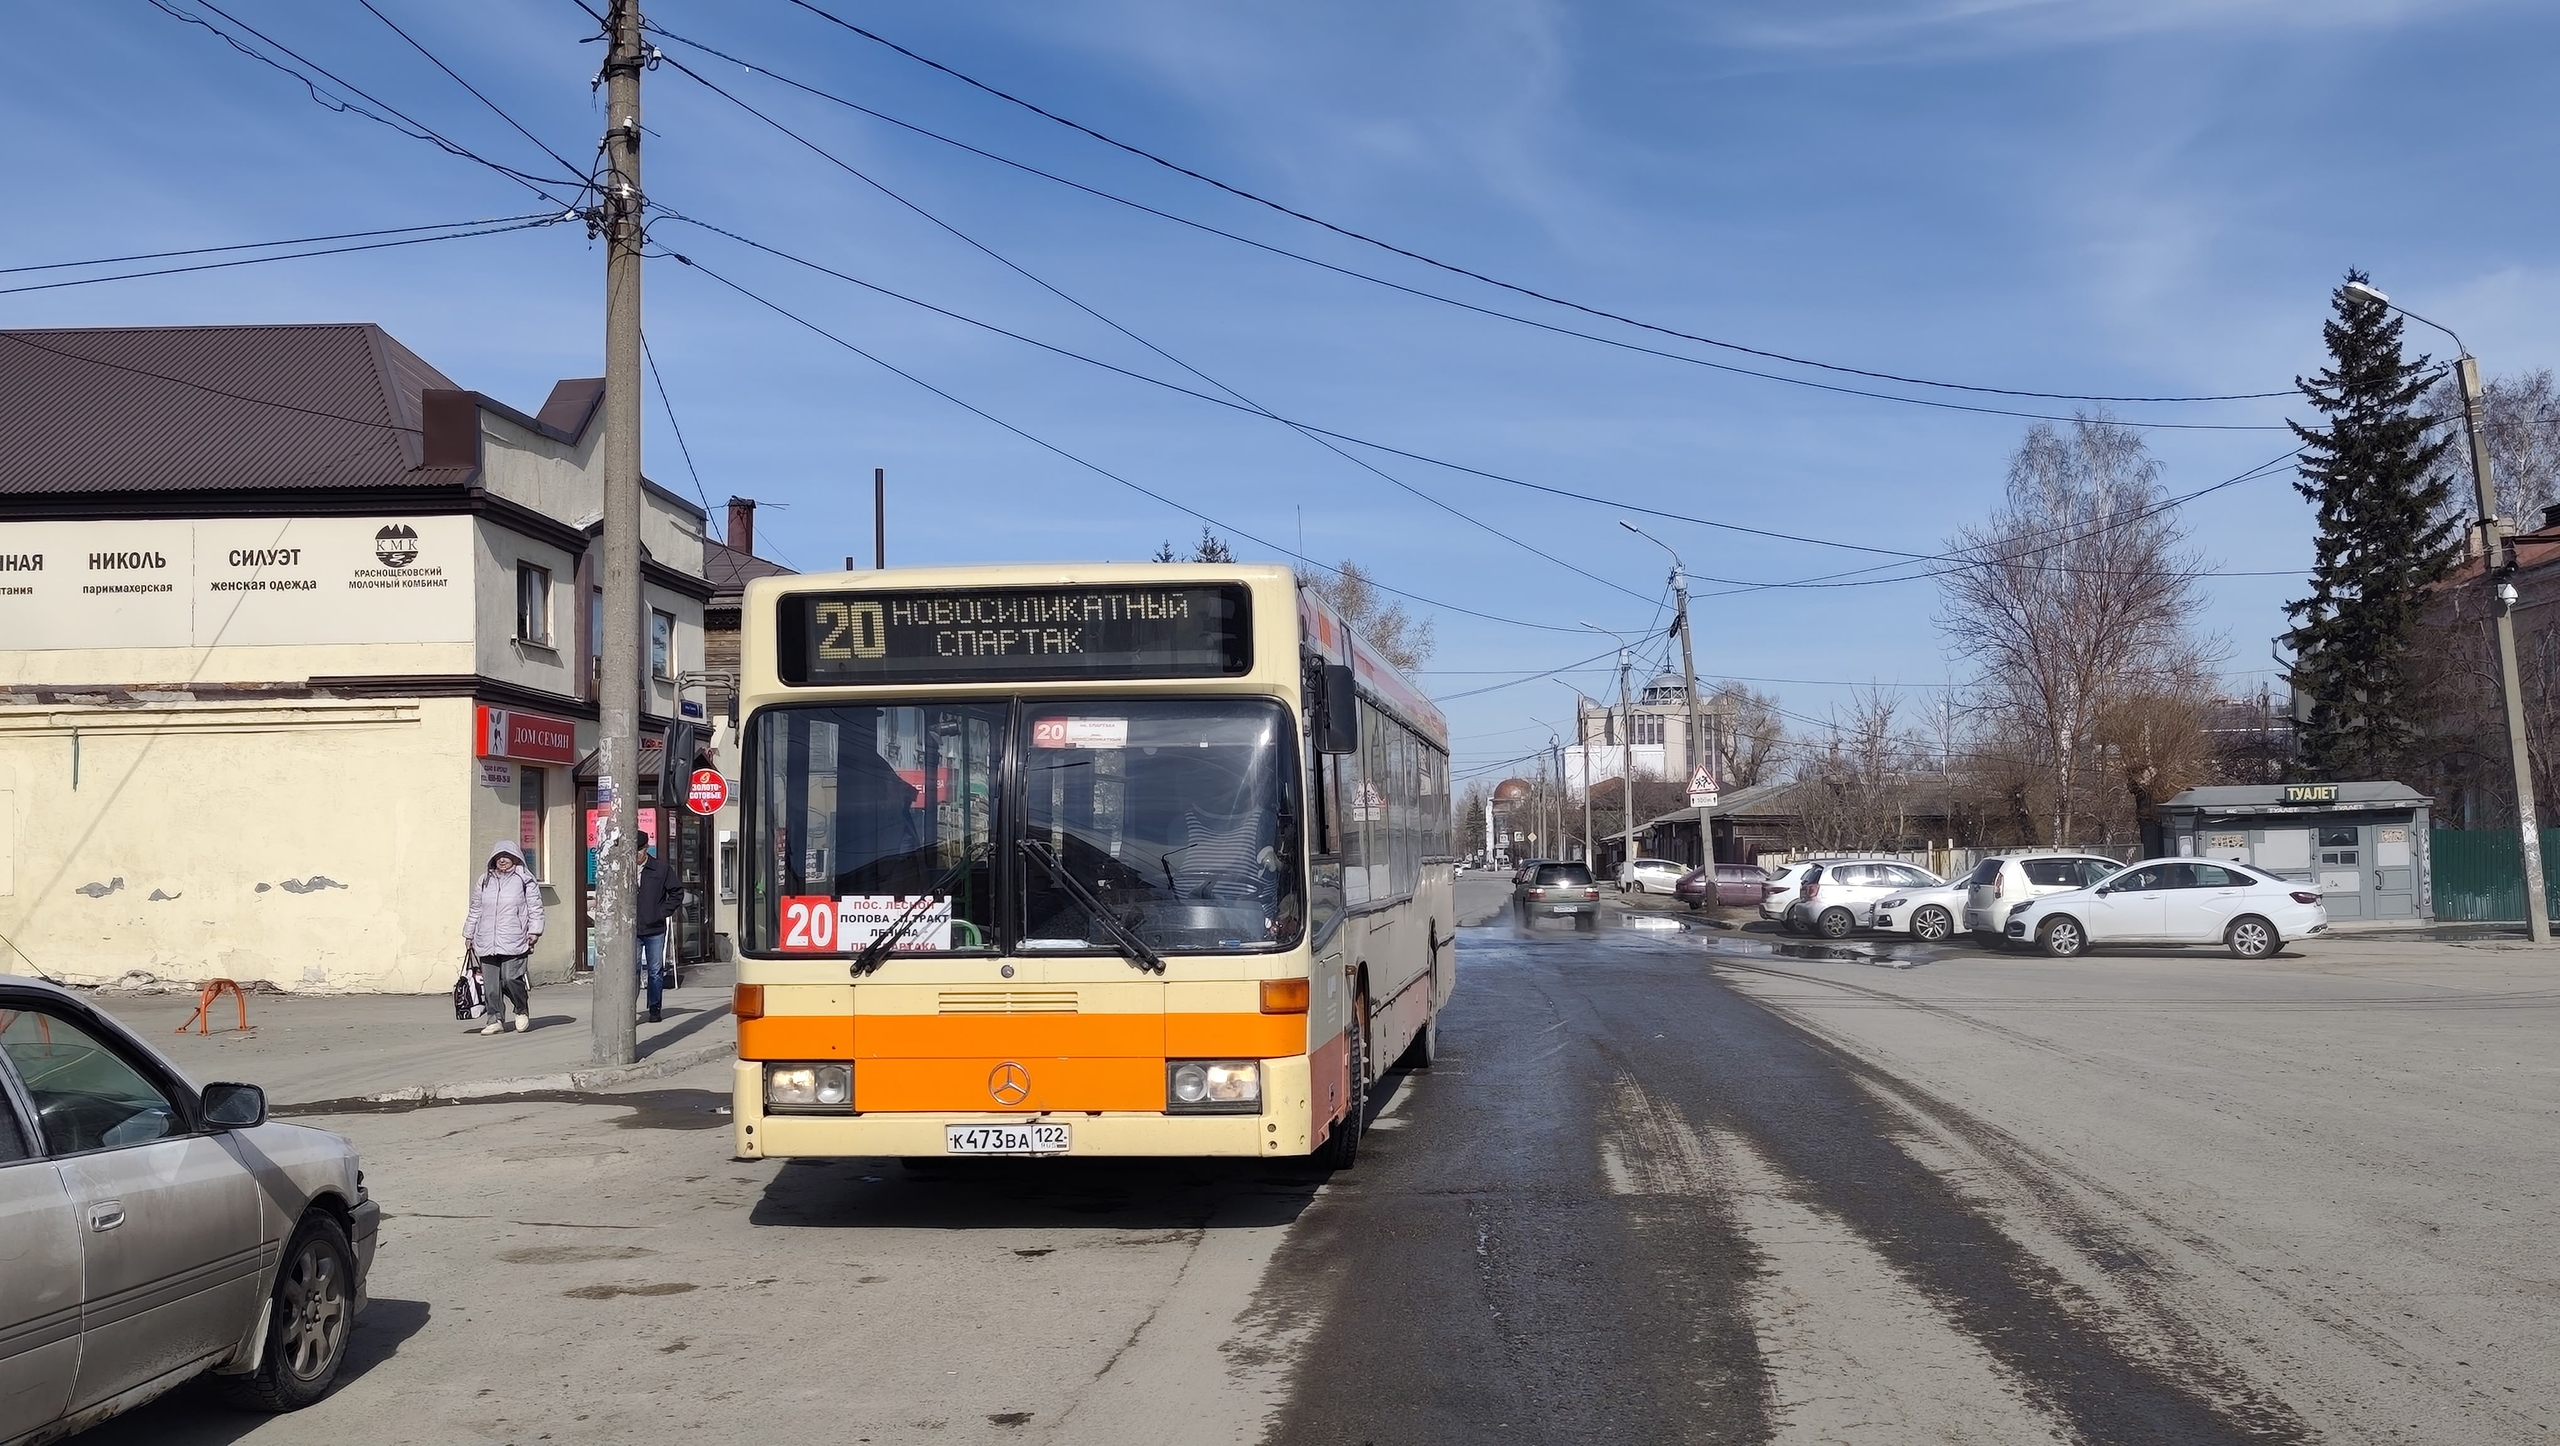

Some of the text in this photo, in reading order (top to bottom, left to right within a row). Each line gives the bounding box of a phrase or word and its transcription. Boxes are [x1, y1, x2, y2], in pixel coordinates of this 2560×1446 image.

[0, 554, 44, 572] НАЯ
[88, 551, 167, 570] НИКОЛЬ
[228, 549, 301, 567] СИЛУЭТ
[354, 566, 442, 578] КРАСНОЩЕКОВСКИЙ
[0, 586, 33, 596] тания
[82, 583, 173, 597] парикмахерская
[210, 579, 317, 592] женская одежда
[348, 578, 448, 589] МОЛОЧНЫЙ КОМБИНАТ
[893, 593, 1190, 626] НОВОСИЛИКАТНЫЙ
[815, 602, 886, 660] 20
[936, 627, 1084, 657] СПАРТАК
[514, 727, 569, 749] ДОМ СЕМЯН
[1036, 724, 1064, 740] 20
[2287, 786, 2338, 801] ТУАЛЕТ
[854, 901, 882, 910] ПОС.
[786, 903, 833, 947] 20
[840, 914, 889, 923] ПОПОВА
[953, 1127, 1064, 1149] К473ВА 122
